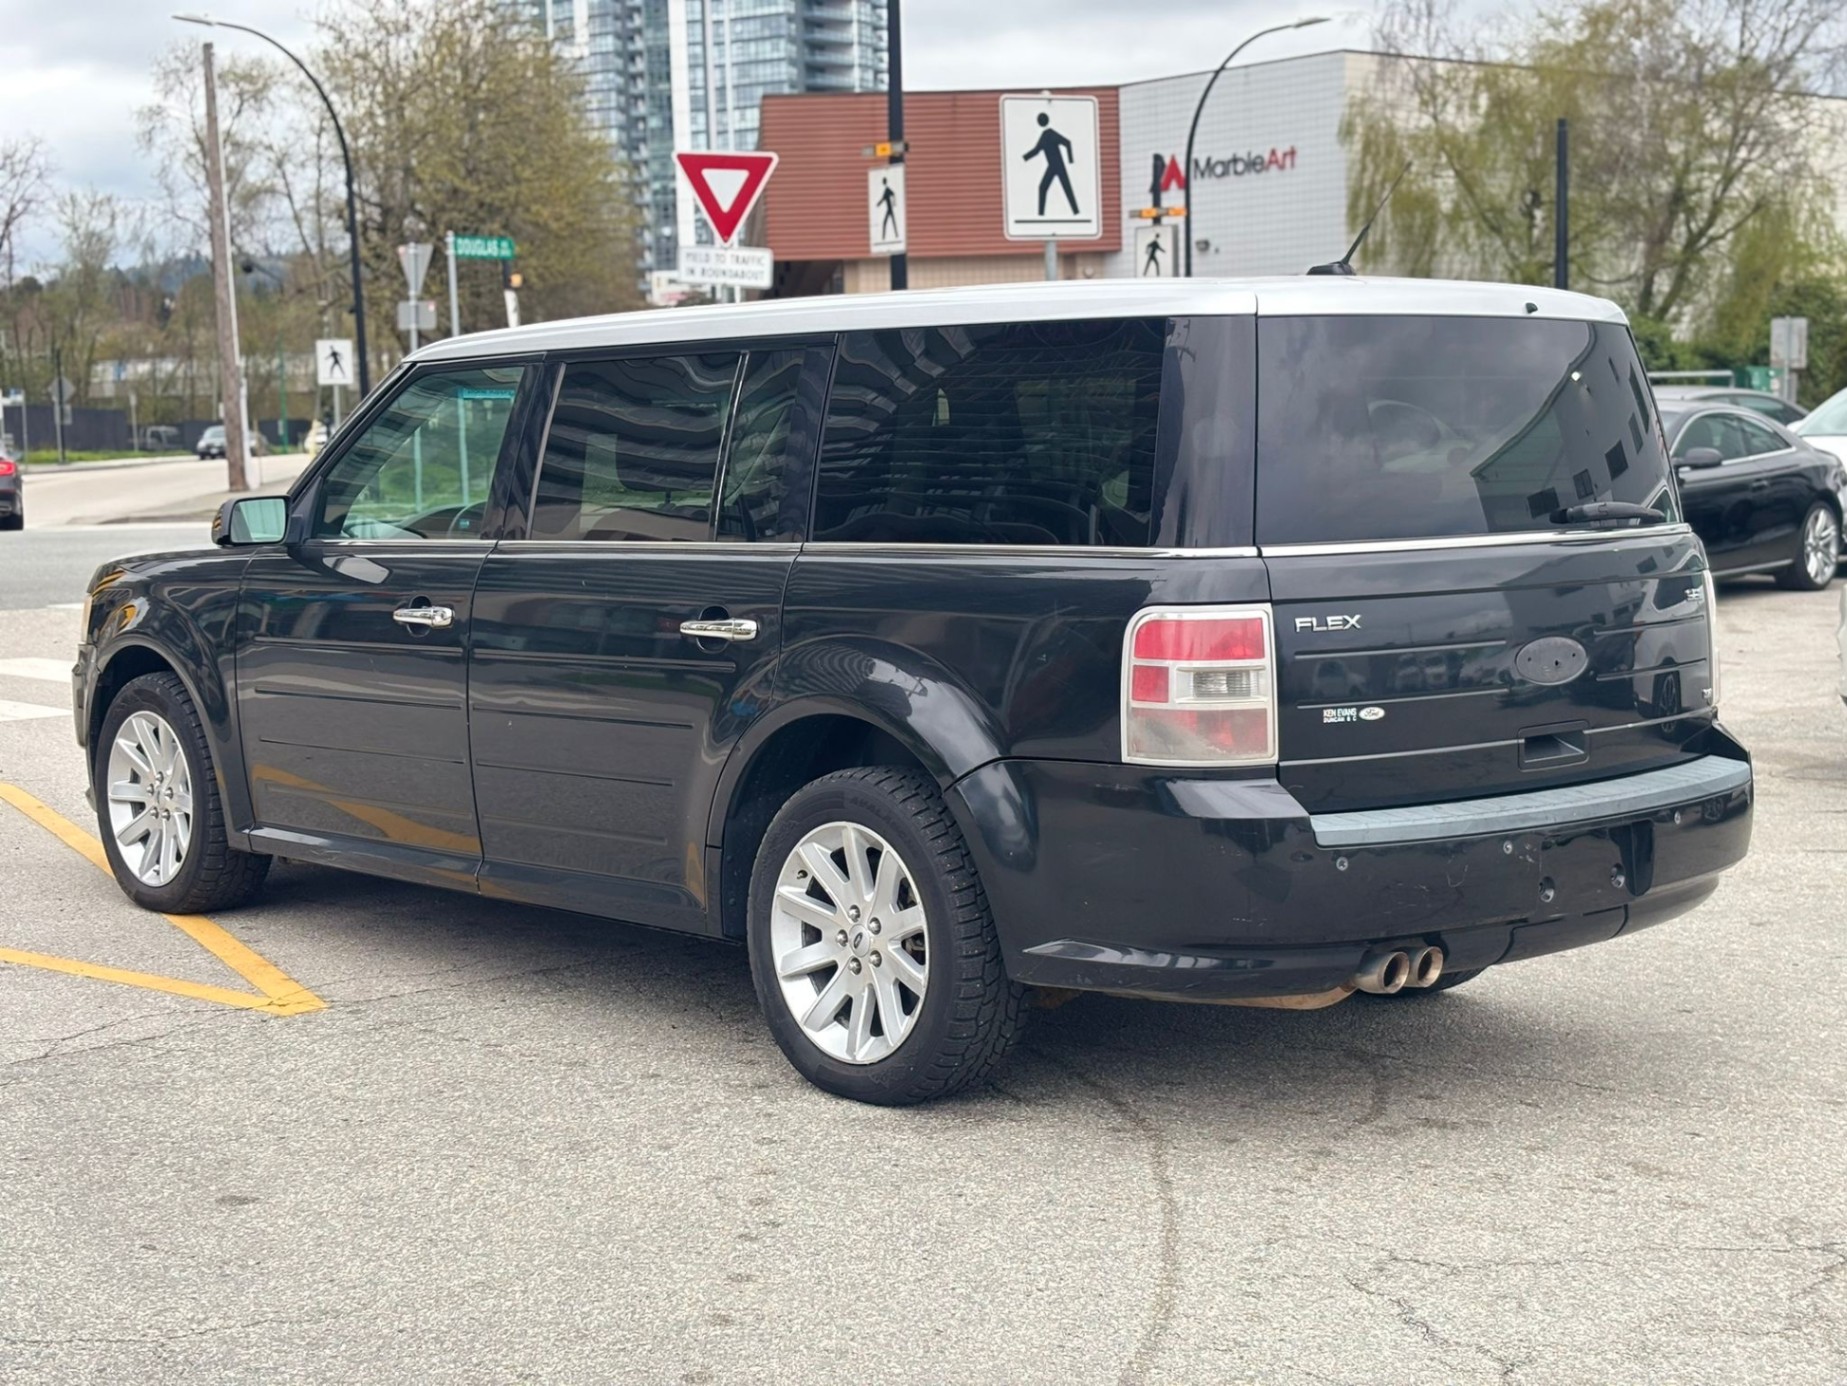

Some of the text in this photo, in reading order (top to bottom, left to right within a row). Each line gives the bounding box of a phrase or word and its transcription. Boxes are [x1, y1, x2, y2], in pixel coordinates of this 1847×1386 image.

[1193, 145, 1297, 180] MarbleArt
[456, 237, 499, 257] DOUGLAS
[715, 252, 727, 265] TO
[730, 253, 765, 267] TRAFFIC
[685, 266, 765, 281] IN ROUNDABOUT
[1295, 614, 1361, 633] FLEX
[1323, 707, 1357, 718] KEN EVANS
